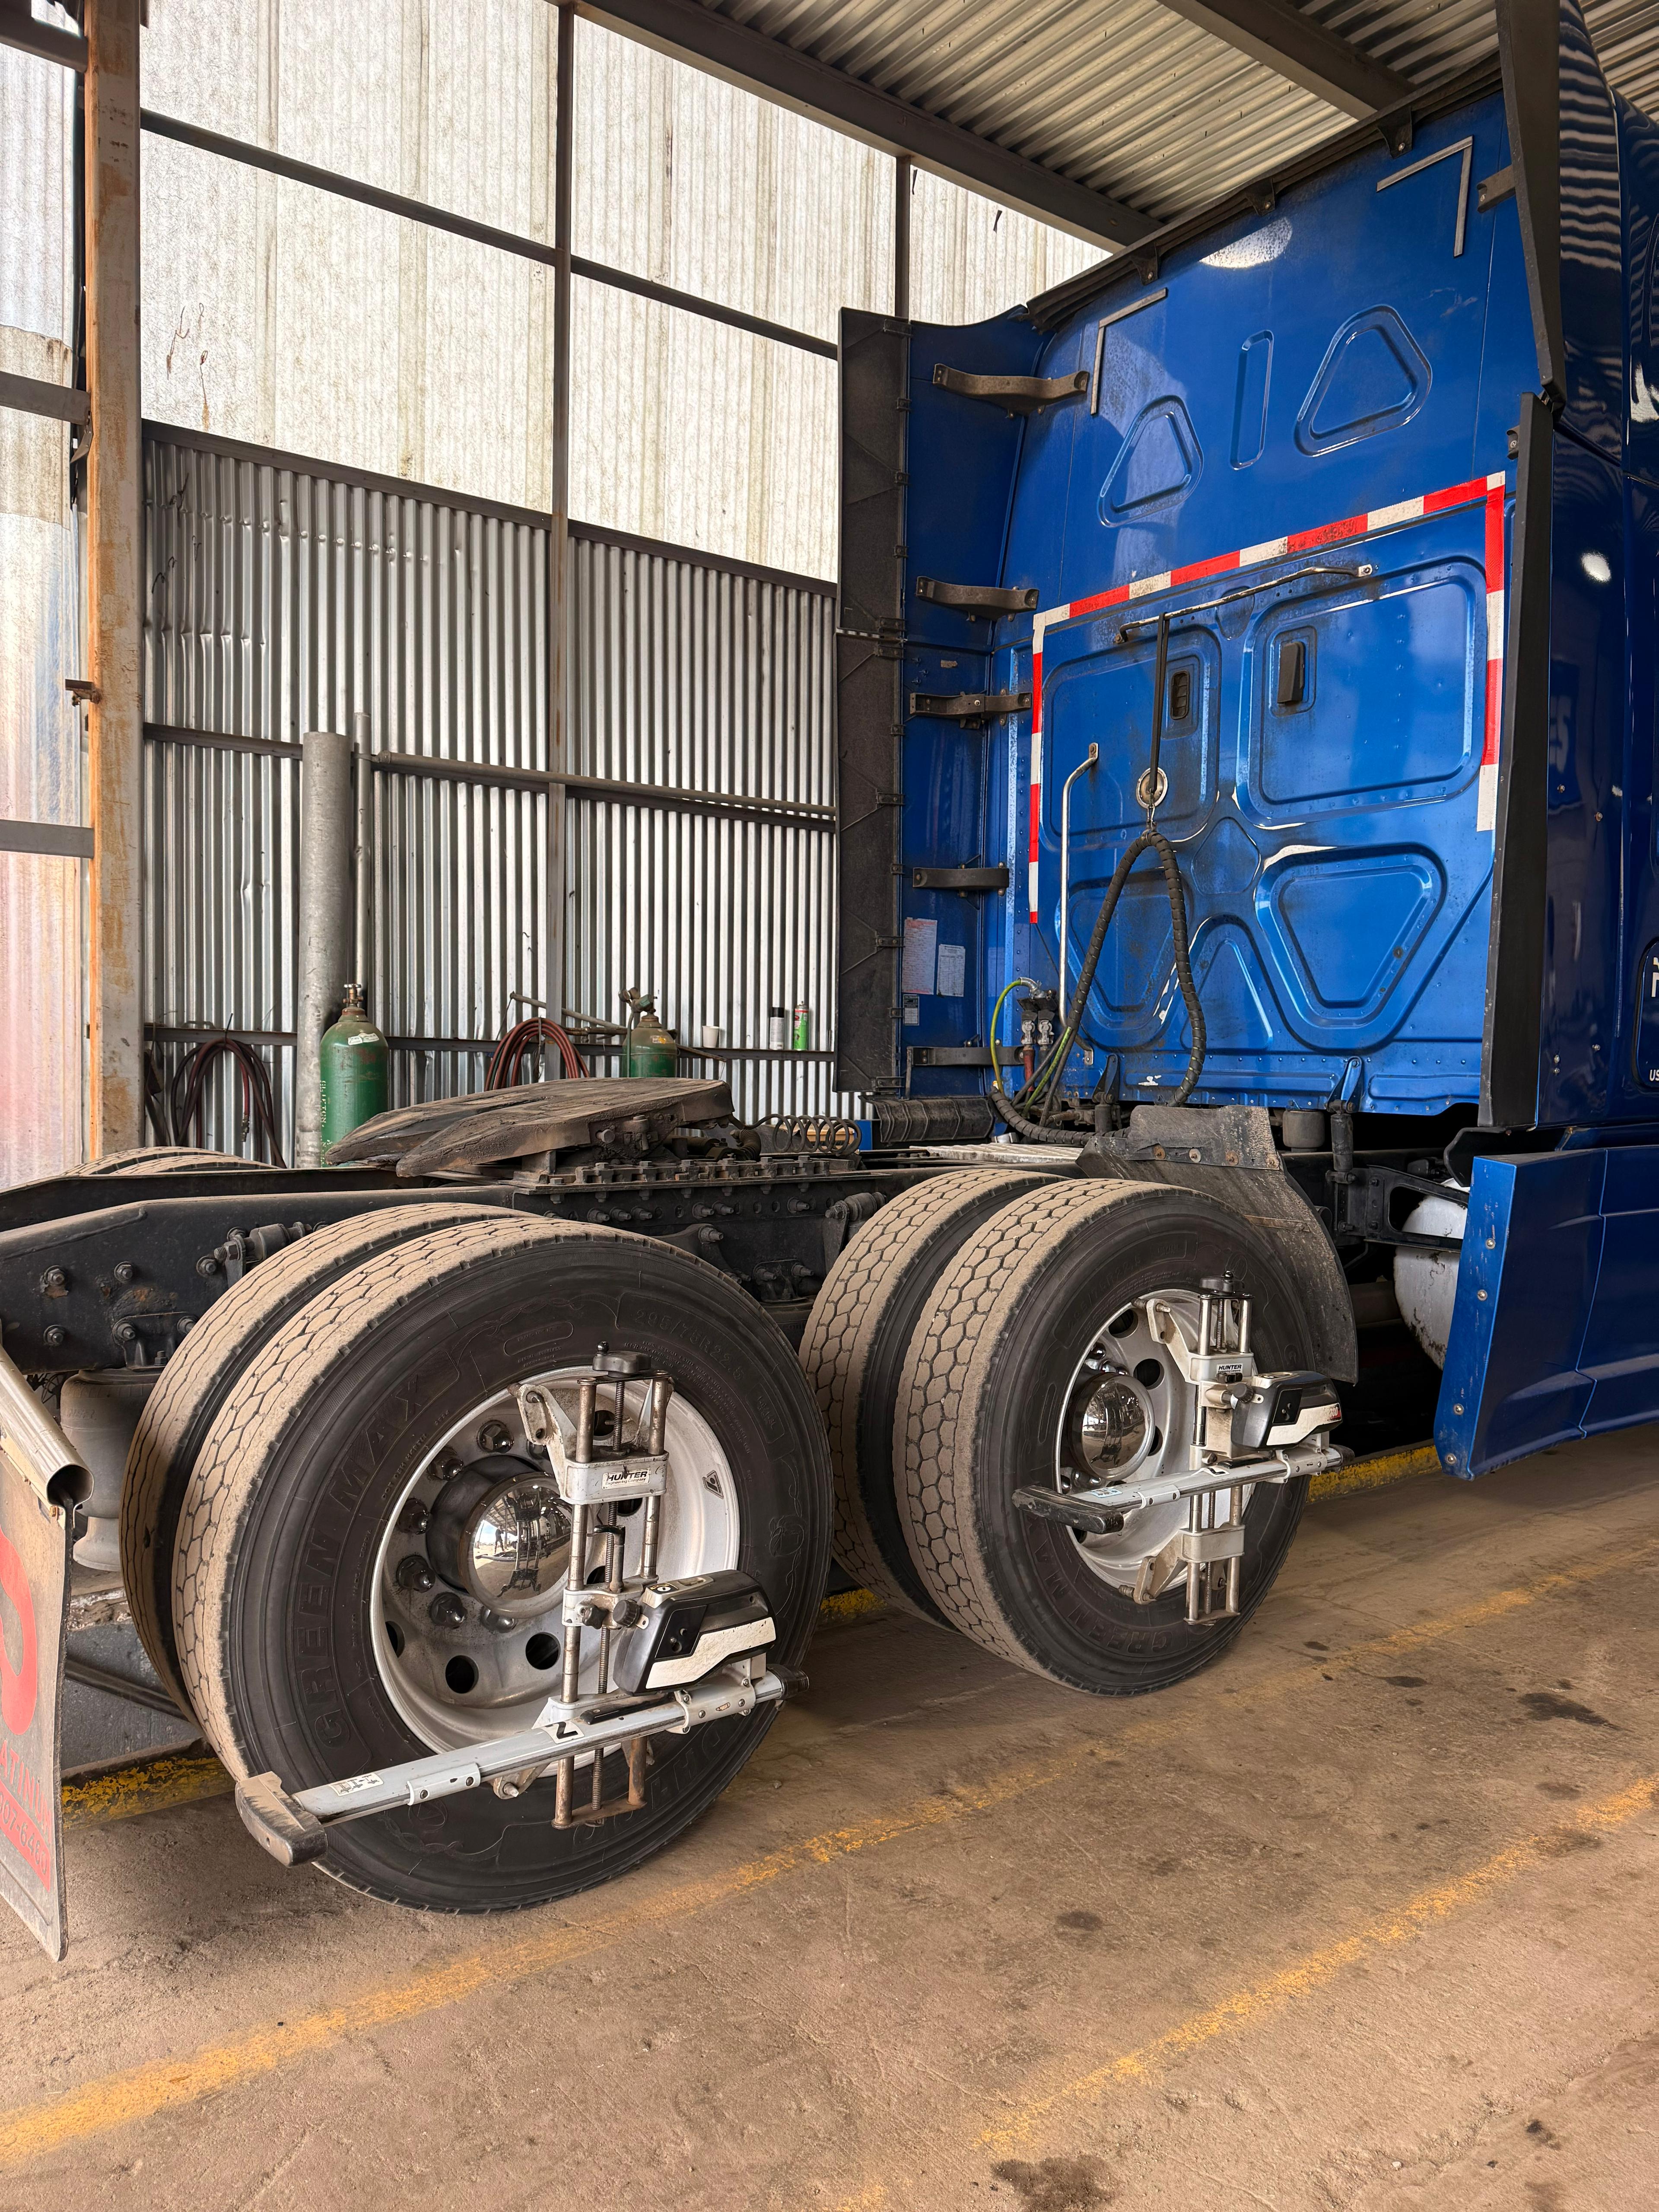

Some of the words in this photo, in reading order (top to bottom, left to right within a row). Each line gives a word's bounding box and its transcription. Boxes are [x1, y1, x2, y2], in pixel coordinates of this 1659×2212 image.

[607, 1471, 648, 1481] HUNTER
[298, 1529, 351, 1750] GREEN
[329, 1374, 422, 1512] MAX
[545, 1721, 578, 1739] 2
